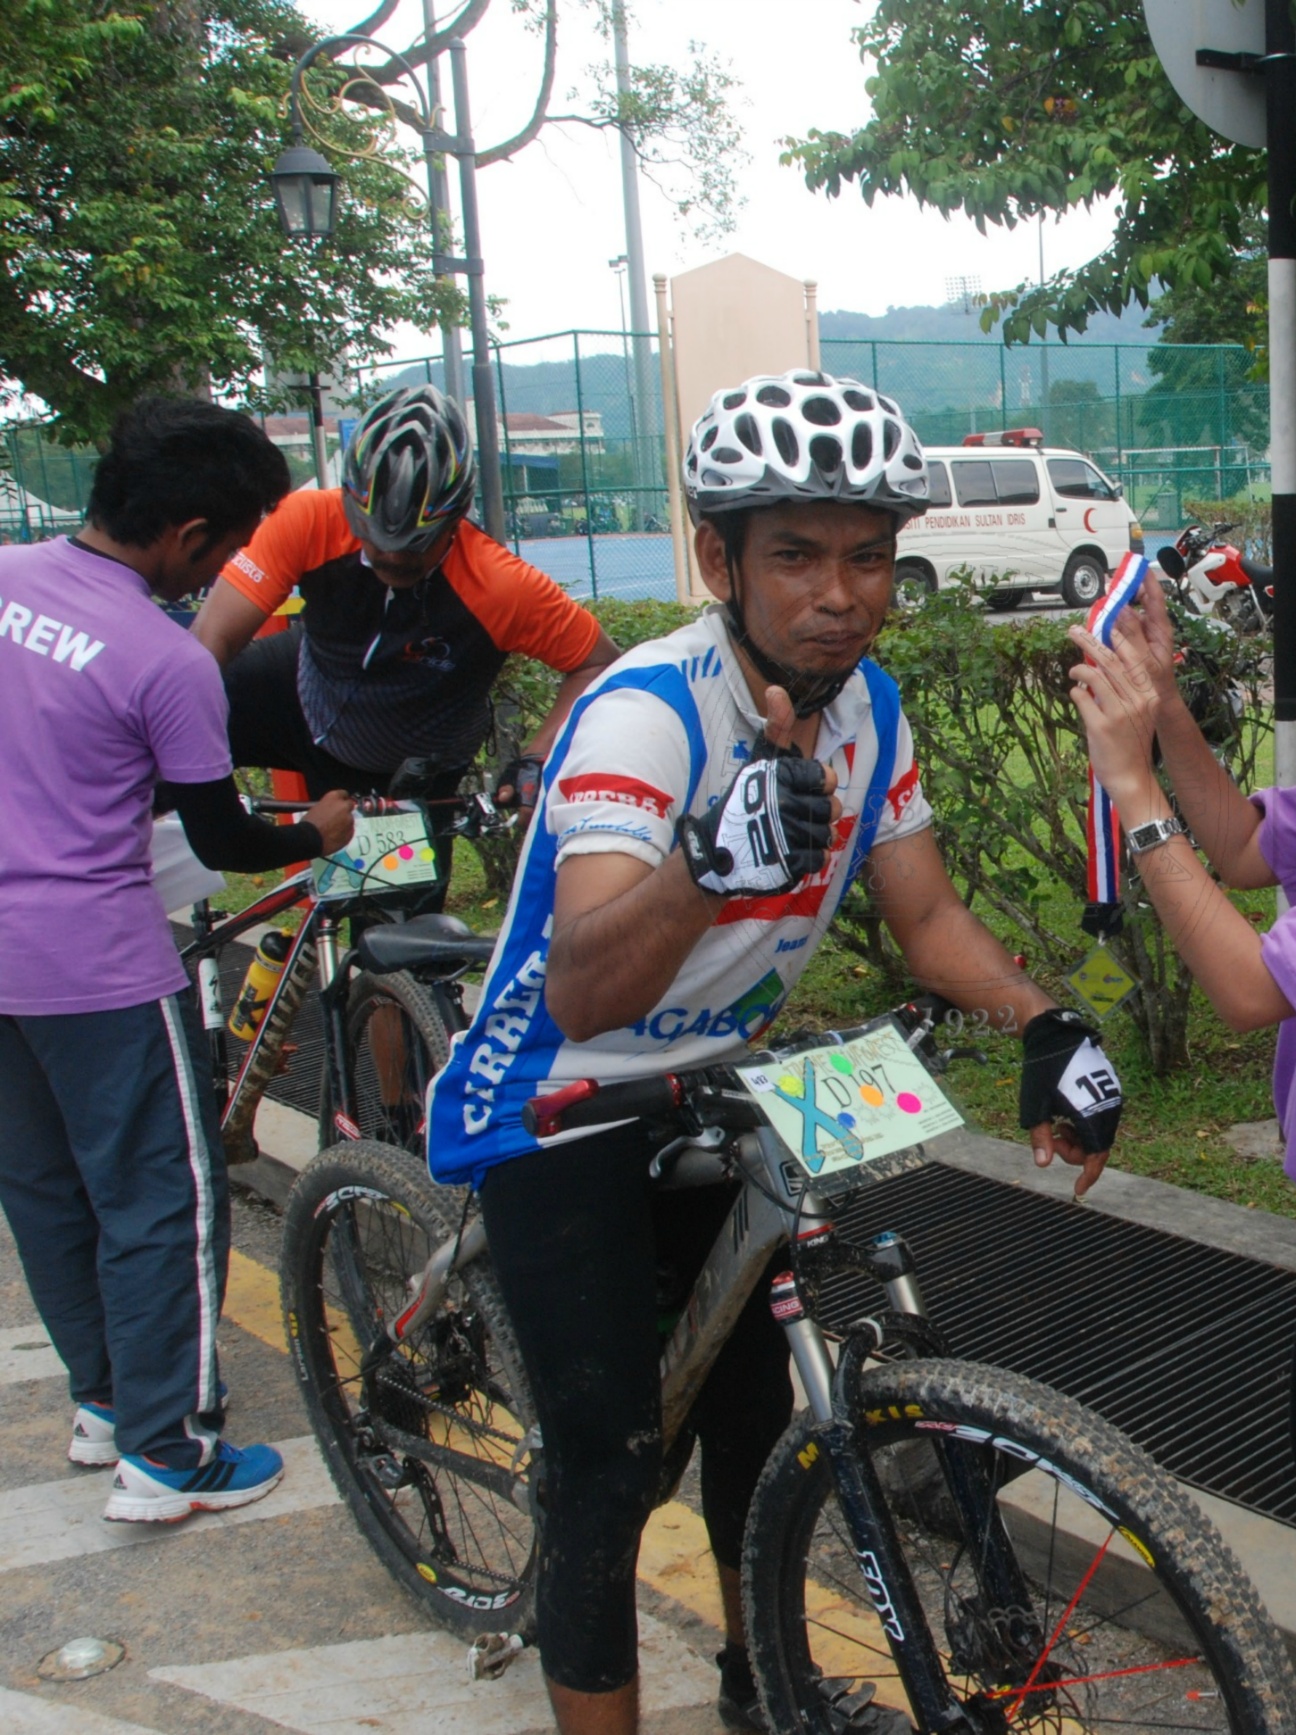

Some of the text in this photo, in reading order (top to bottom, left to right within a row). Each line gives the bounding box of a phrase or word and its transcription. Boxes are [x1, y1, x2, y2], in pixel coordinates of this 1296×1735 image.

[925, 516, 971, 529] PENDIDIKAN
[976, 514, 1003, 527] SULTAN
[1007, 512, 1026, 525] IDRIS
[0, 596, 106, 672] REW
[357, 831, 406, 857] D 583
[821, 1064, 897, 1108] D 197
[1075, 1069, 1121, 1102] 12
[807, 1234, 829, 1248] KING
[773, 1301, 799, 1315] CING
